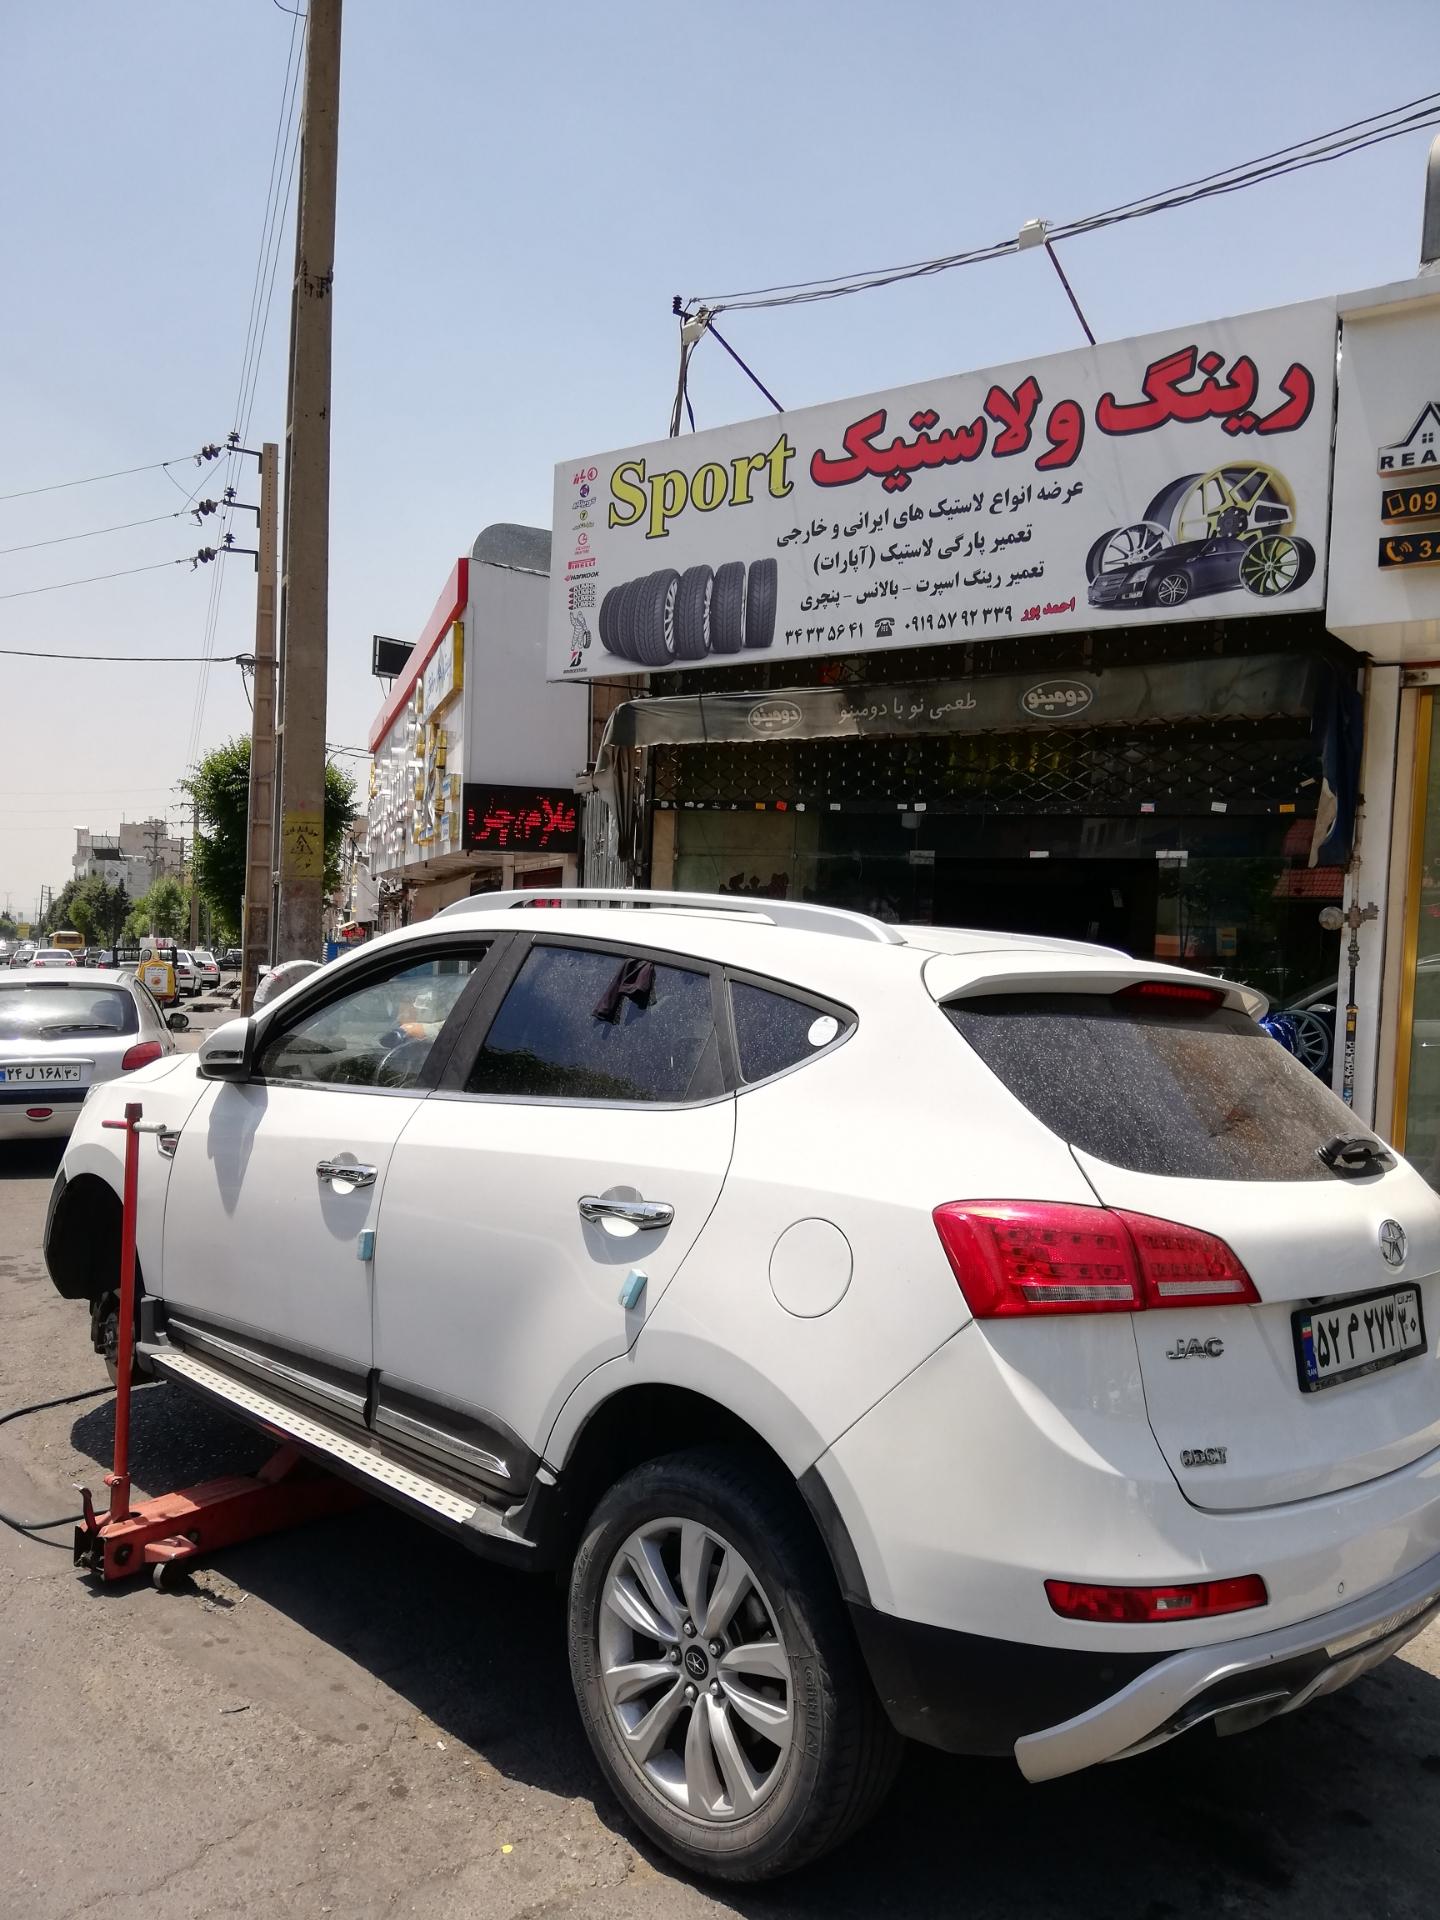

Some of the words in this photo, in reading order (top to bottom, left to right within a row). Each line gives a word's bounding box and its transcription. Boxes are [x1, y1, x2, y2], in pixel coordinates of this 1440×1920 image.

[1095, 344, 1316, 437] رینگ
[809, 375, 1043, 494] لاستیک
[1034, 399, 1086, 472] و
[1380, 449, 1438, 470] REA
[608, 433, 797, 540] Sport
[989, 484, 1032, 515] انواع
[1037, 481, 1084, 505] عرضه
[893, 503, 924, 530] های
[928, 491, 985, 521] لاستیک
[776, 518, 828, 548] خارجی
[831, 523, 840, 540] و
[843, 508, 890, 537] ایرانی
[880, 537, 934, 565] لاستیک
[937, 530, 986, 560] پارگی
[989, 523, 1033, 554] تعمیر
[567, 557, 597, 570] PIRELLI
[1005, 560, 1045, 588] تعمیر
[856, 578, 899, 605] بالانس
[916, 570, 960, 597] اسپرت
[963, 569, 1002, 589] رینگ
[800, 589, 841, 612] پنچری
[1042, 596, 1076, 615] احمد
[929, 693, 978, 720] طعمی
[1025, 685, 1090, 709] دومینو
[750, 706, 800, 728] دومینو
[837, 702, 888, 725] دومینو
[1166, 1336, 1225, 1361] JAC
[1317, 1317, 1340, 1368] ۵۲
